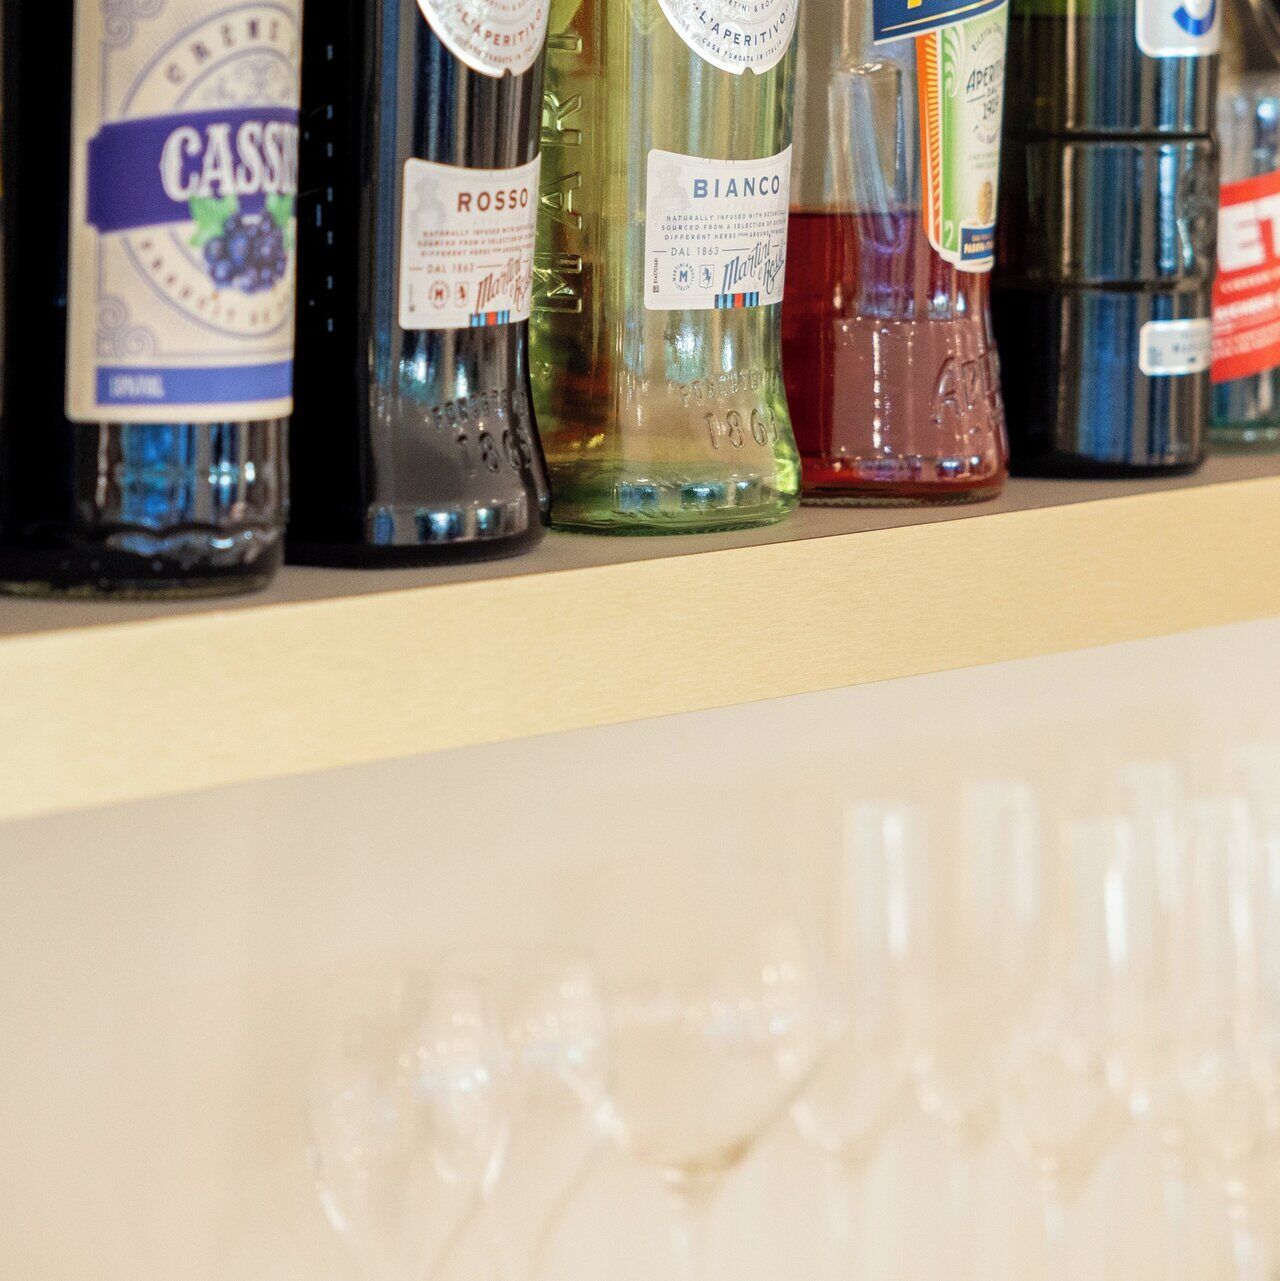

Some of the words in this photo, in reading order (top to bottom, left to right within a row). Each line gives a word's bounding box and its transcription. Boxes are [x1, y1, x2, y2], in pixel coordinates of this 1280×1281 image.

[699, 10, 786, 47] L'APERITIVO
[693, 175, 780, 199] BIANCO
[457, 187, 529, 213] ROSSO
[666, 214, 714, 222] NATURALLY
[717, 213, 746, 221] INFUSED
[664, 233, 711, 241] DIFFERENT
[670, 247, 691, 257] DAL
[696, 246, 720, 256] 1863
[721, 236, 771, 295] Martini
[679, 270, 688, 282] M
